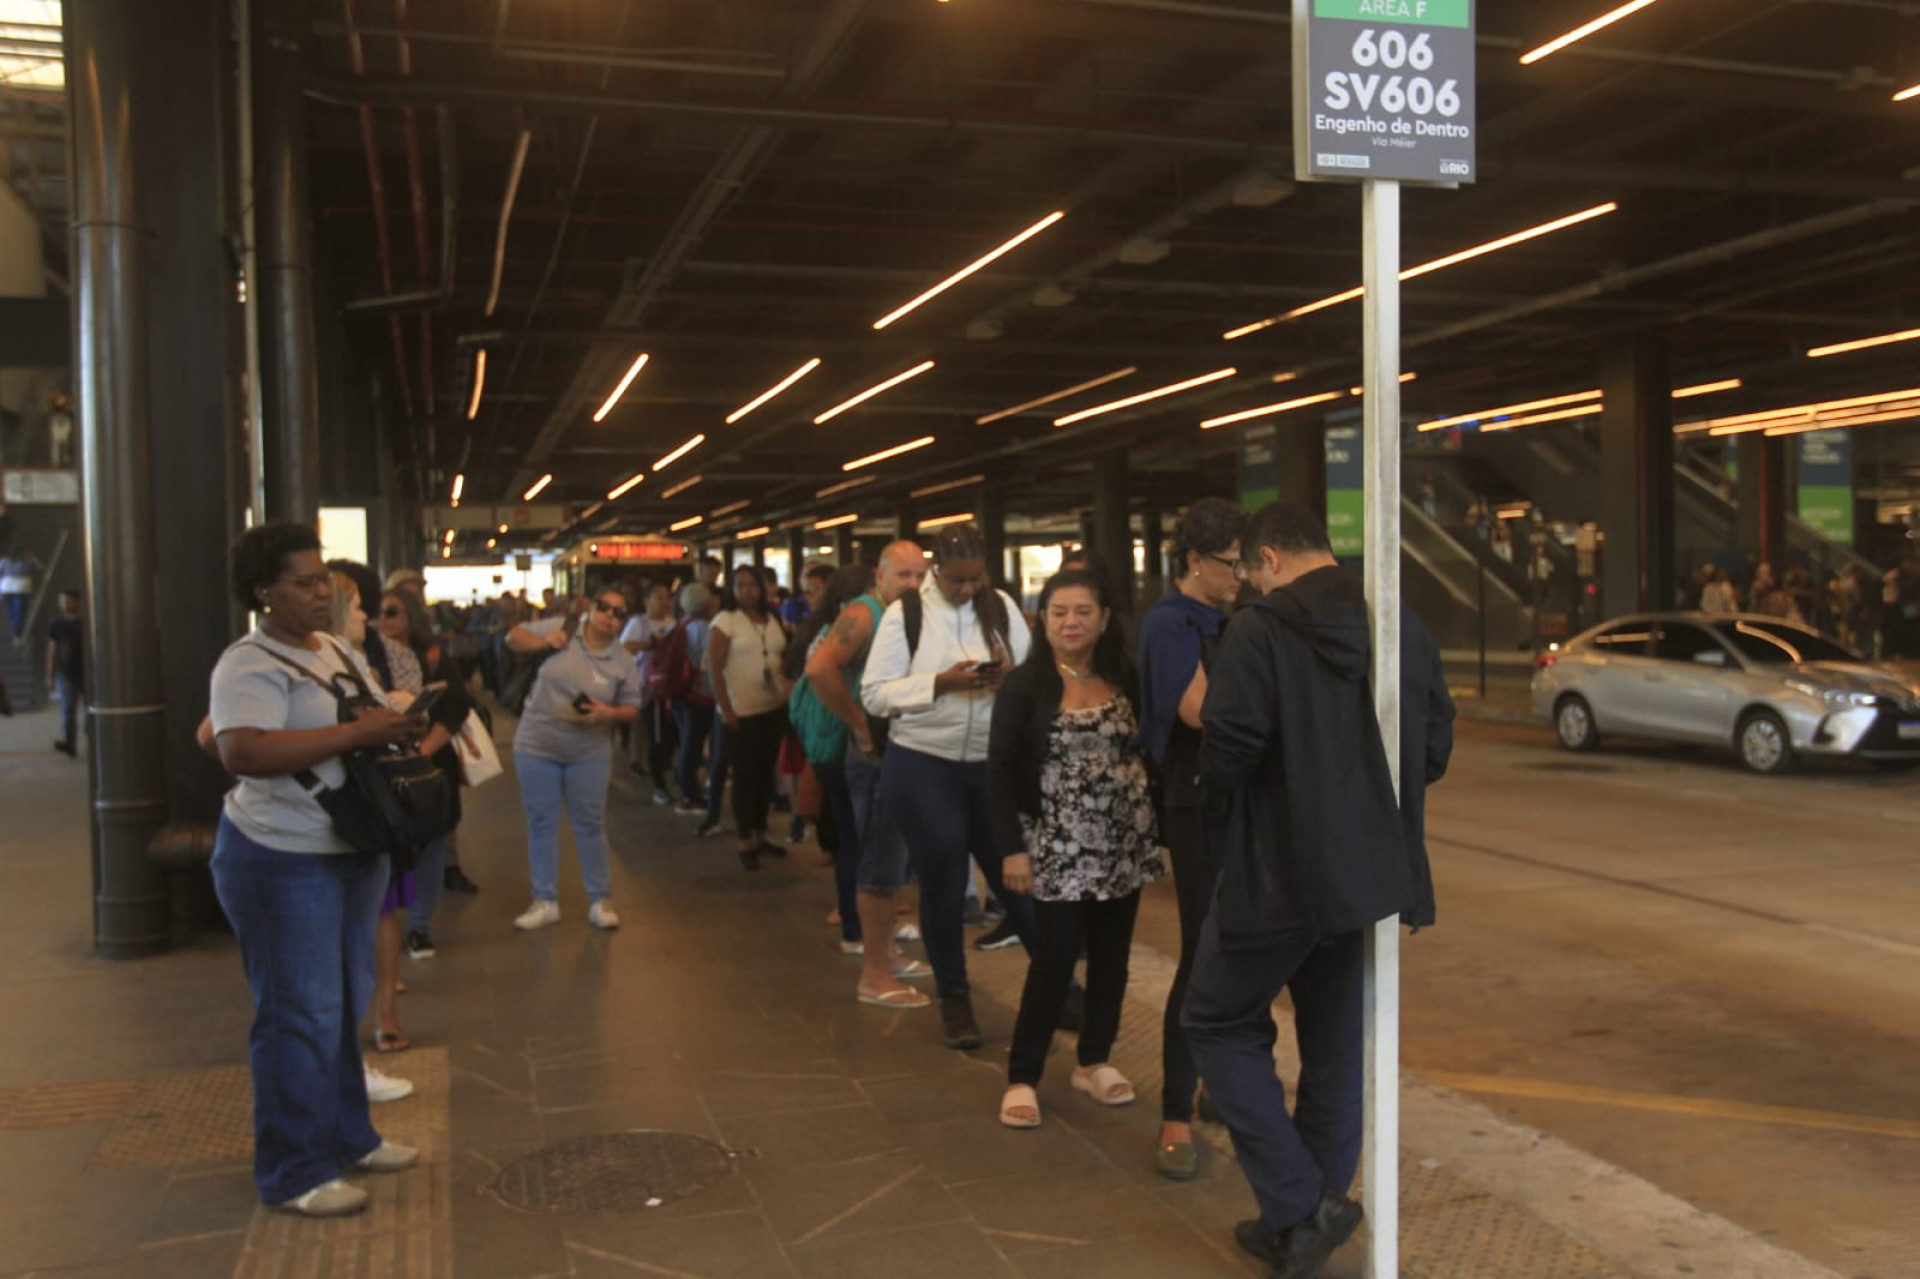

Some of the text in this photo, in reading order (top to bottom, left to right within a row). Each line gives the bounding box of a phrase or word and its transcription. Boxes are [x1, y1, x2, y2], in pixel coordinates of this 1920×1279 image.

[1415, 0, 1428, 18] F
[1352, 29, 1434, 70] 606
[1324, 71, 1461, 116] SV606
[1315, 114, 1469, 138] Engenho de Dentro
[1372, 136, 1388, 146] Via
[1449, 162, 1470, 175] RIO
